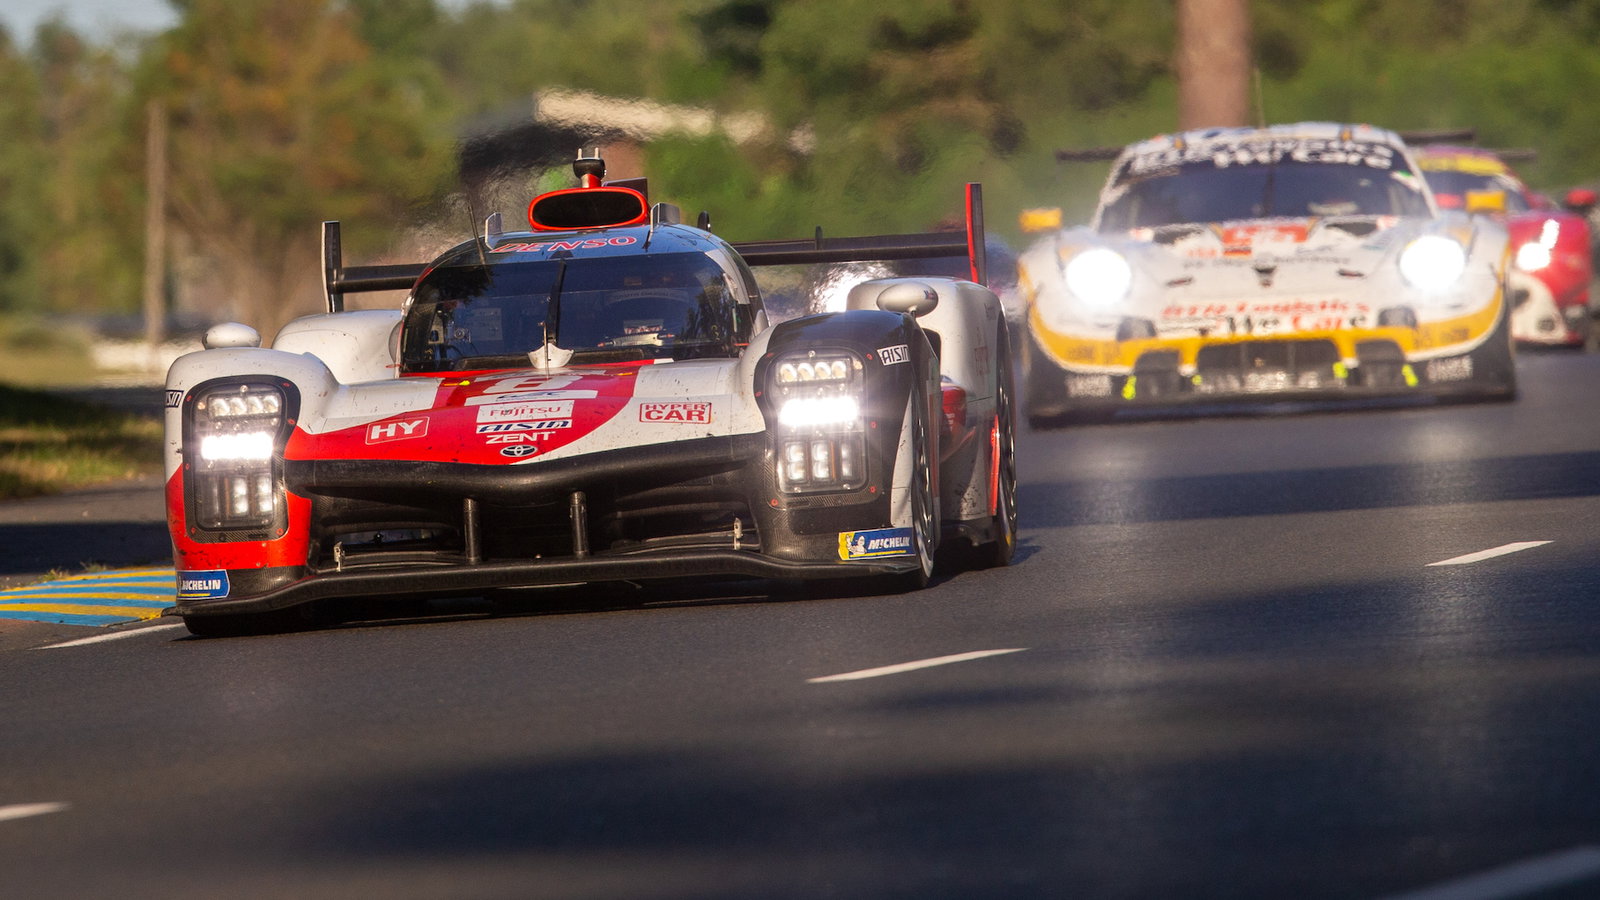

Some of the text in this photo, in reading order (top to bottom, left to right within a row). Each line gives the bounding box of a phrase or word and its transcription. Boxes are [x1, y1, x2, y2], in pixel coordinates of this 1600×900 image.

[489, 236, 637, 253] DENSO
[490, 405, 561, 417] FUJITSU
[645, 410, 704, 421] CAR
[371, 420, 424, 439] HY
[478, 420, 570, 433] AISIN
[486, 432, 556, 444] ZENT
[868, 537, 910, 549] MICHELIN
